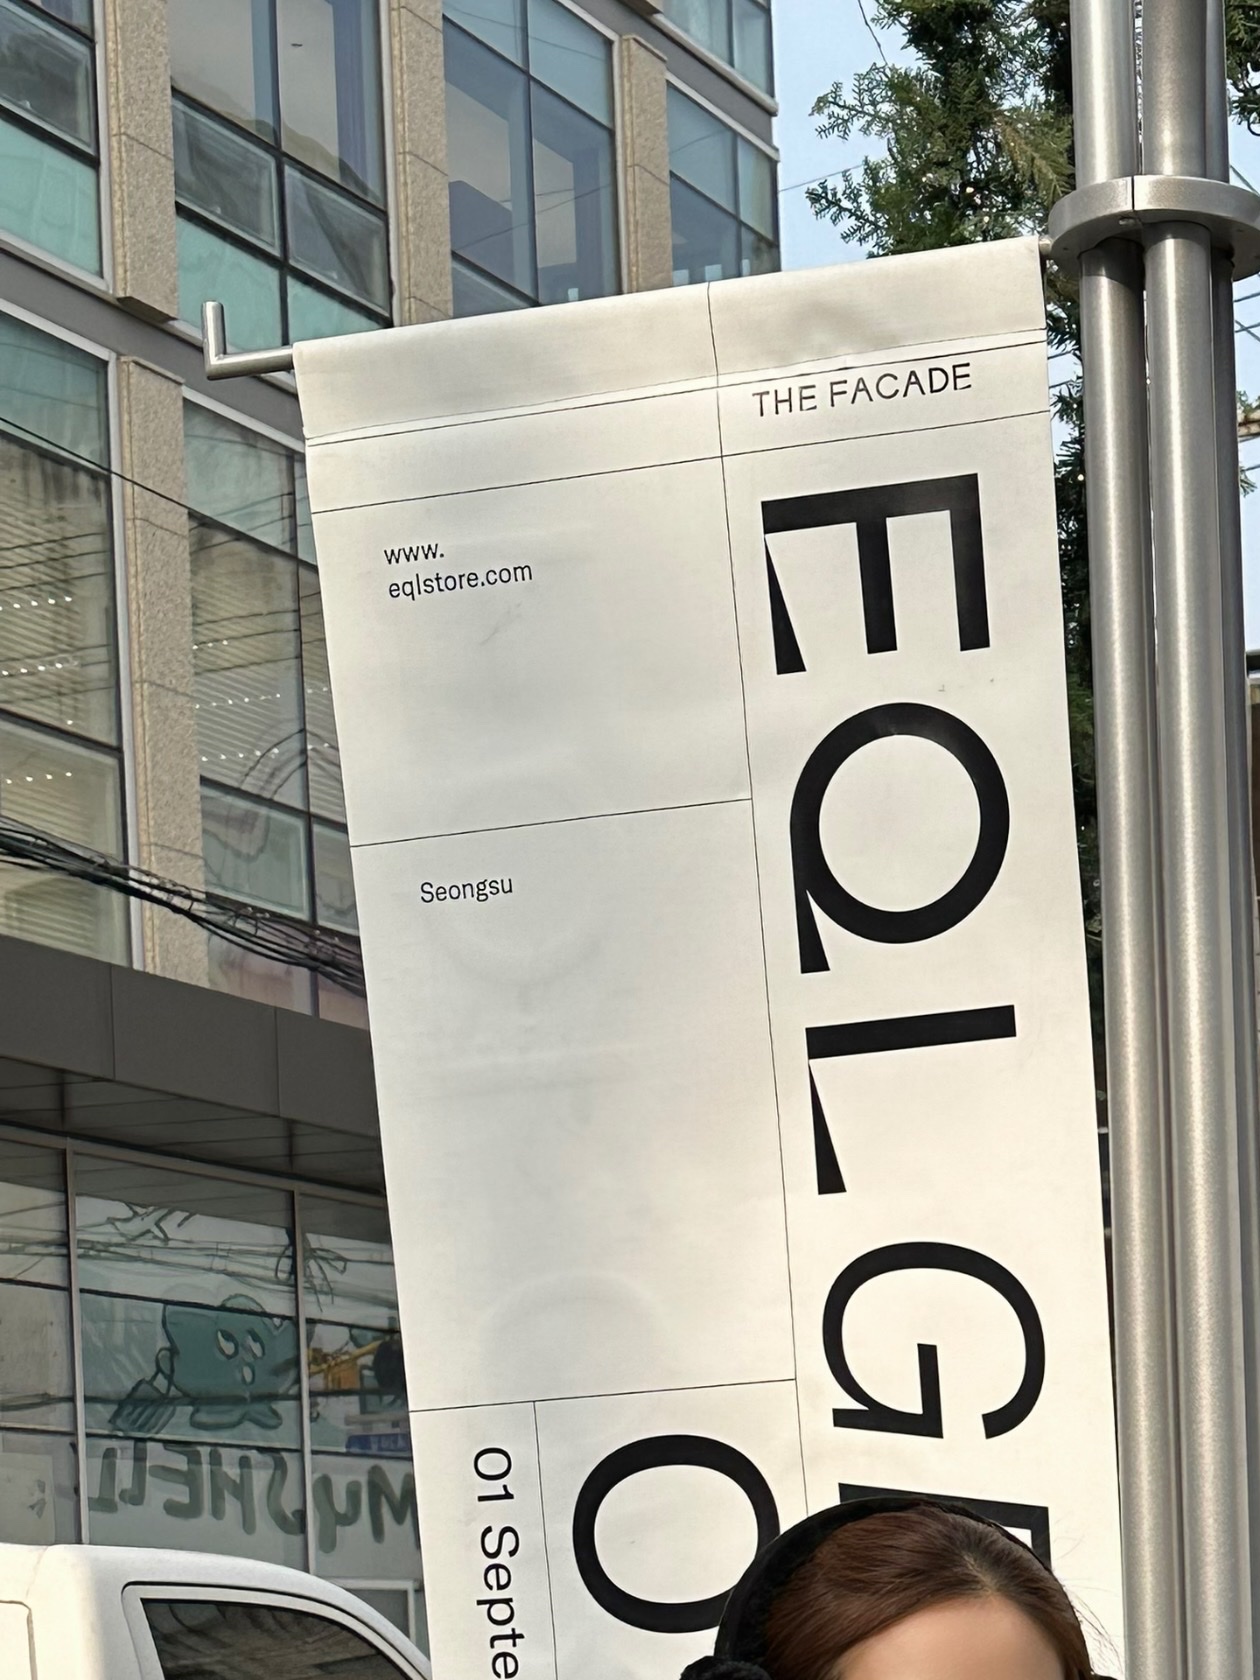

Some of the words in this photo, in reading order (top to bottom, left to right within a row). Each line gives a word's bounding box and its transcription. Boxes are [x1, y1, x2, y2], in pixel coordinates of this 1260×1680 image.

[752, 385, 818, 418] THE
[829, 363, 974, 409] FACADE
[383, 542, 445, 566] www.
[386, 560, 533, 601] eqlstore.com
[420, 876, 514, 904] Seongsu
[473, 1447, 515, 1503] 01
